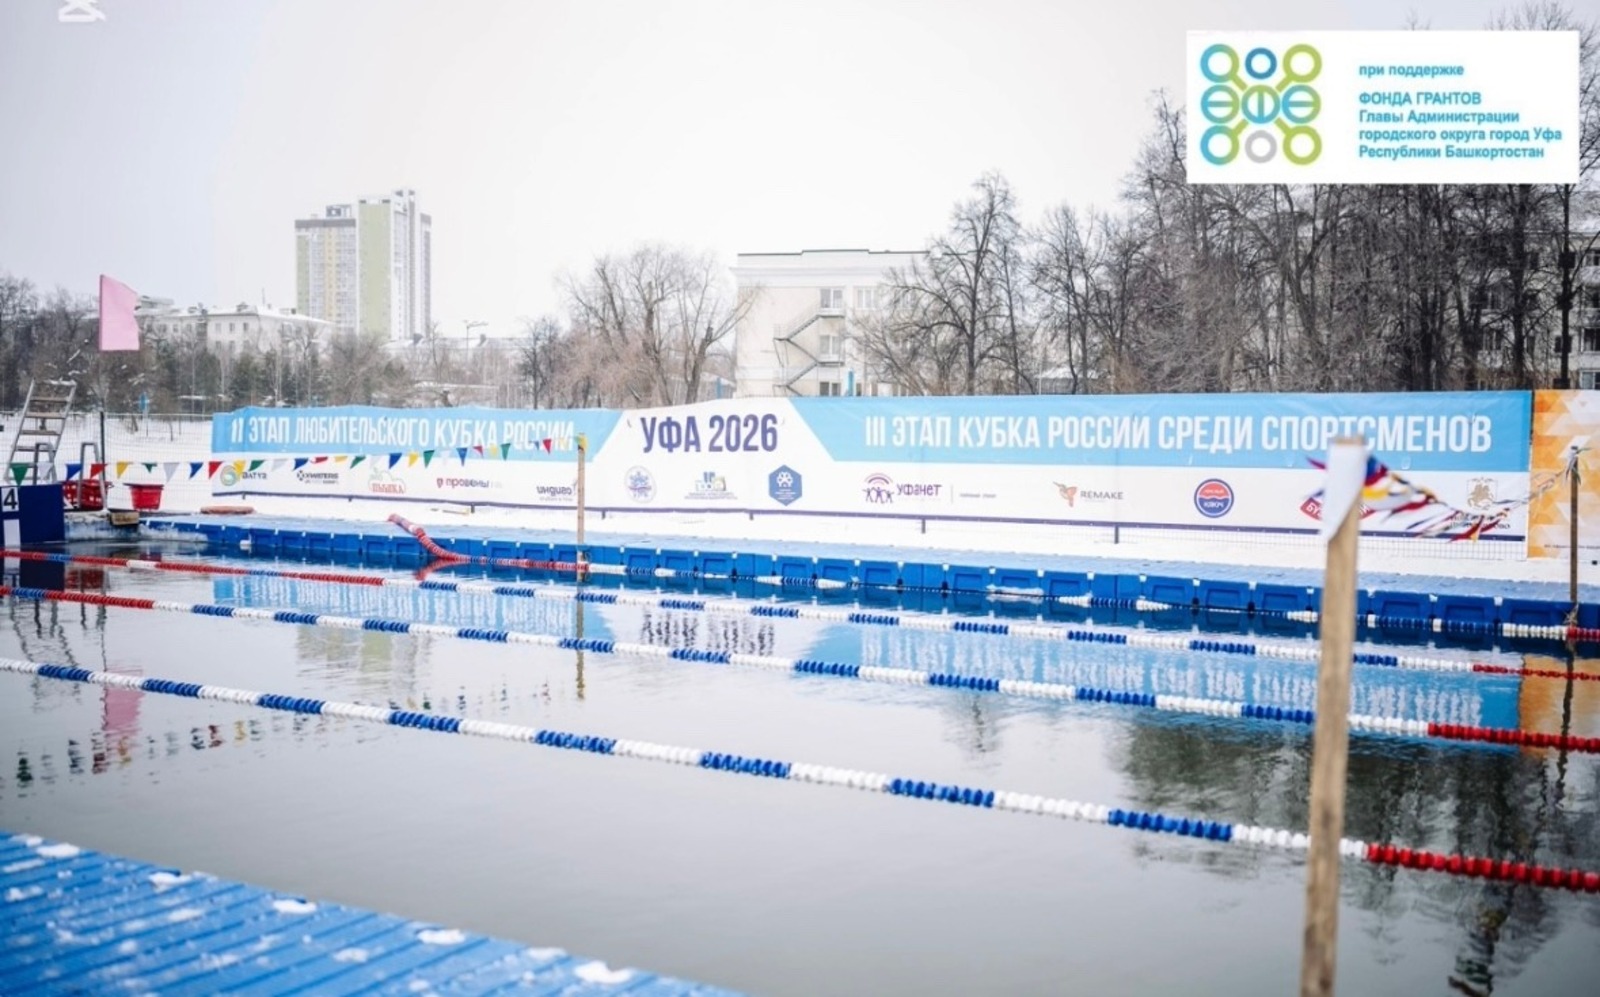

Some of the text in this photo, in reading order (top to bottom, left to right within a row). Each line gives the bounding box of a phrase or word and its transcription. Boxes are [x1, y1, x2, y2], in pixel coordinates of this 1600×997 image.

[249, 416, 290, 444] ЭТАП
[294, 416, 430, 447] ЛЮБИТЕЛЬСКОГО
[434, 418, 498, 448] КУБКА
[503, 420, 575, 450] РОССИИ
[640, 413, 778, 453] УФА 2026
[865, 414, 1492, 454] III ЭТАП КУБКА РОССИИ СРЕДИ СПОРТСМЕНОВ
[3, 488, 18, 510] 4
[1080, 490, 1124, 501] REMAKE
